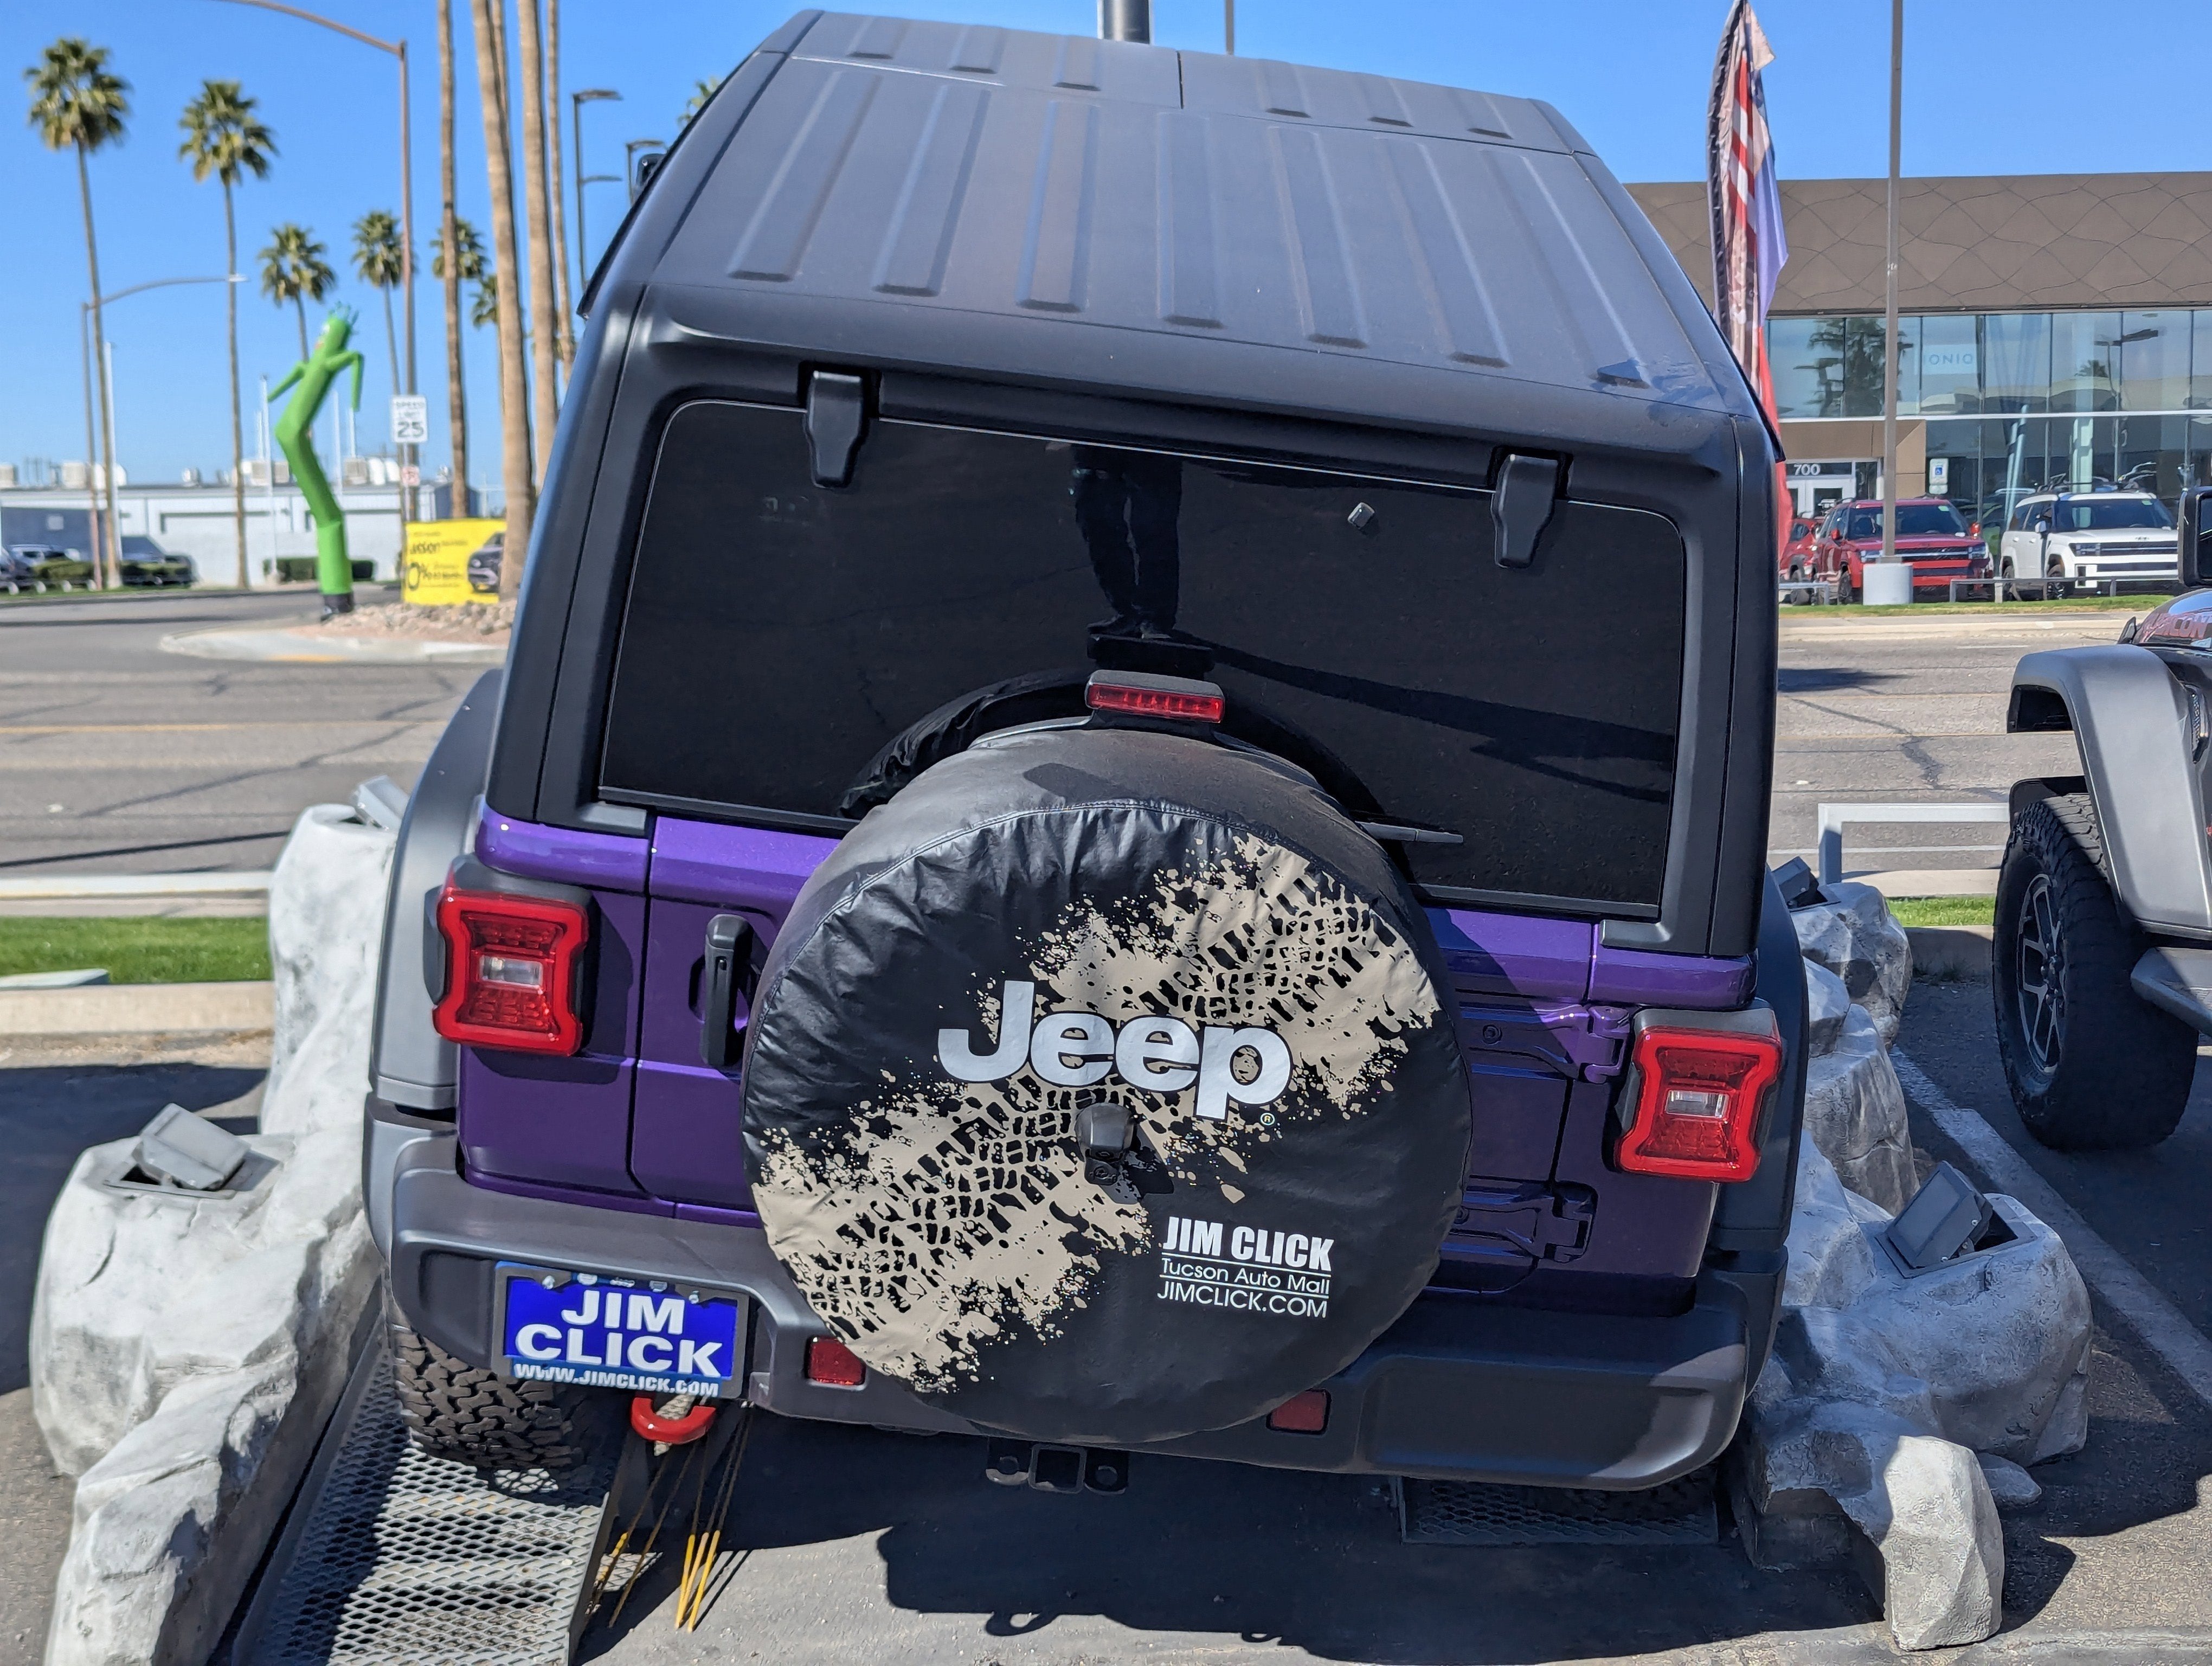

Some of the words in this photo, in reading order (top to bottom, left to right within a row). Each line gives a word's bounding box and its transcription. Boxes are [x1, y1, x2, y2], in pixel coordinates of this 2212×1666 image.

[397, 421, 425, 438] 25
[1793, 464, 1821, 476] 700
[937, 979, 1291, 1120] Jeep
[1162, 1216, 1223, 1257] JIM
[1231, 1226, 1334, 1272] CLICK
[1161, 1258, 1229, 1282] Tucson
[1233, 1267, 1281, 1288] Auto
[1287, 1274, 1330, 1295] Mall
[561, 1290, 685, 1335] JIM
[1156, 1280, 1328, 1318] JIMCLICK.COM
[515, 1323, 723, 1378] CLICK
[513, 1363, 719, 1397] WWW.JIMCLICK.COM
